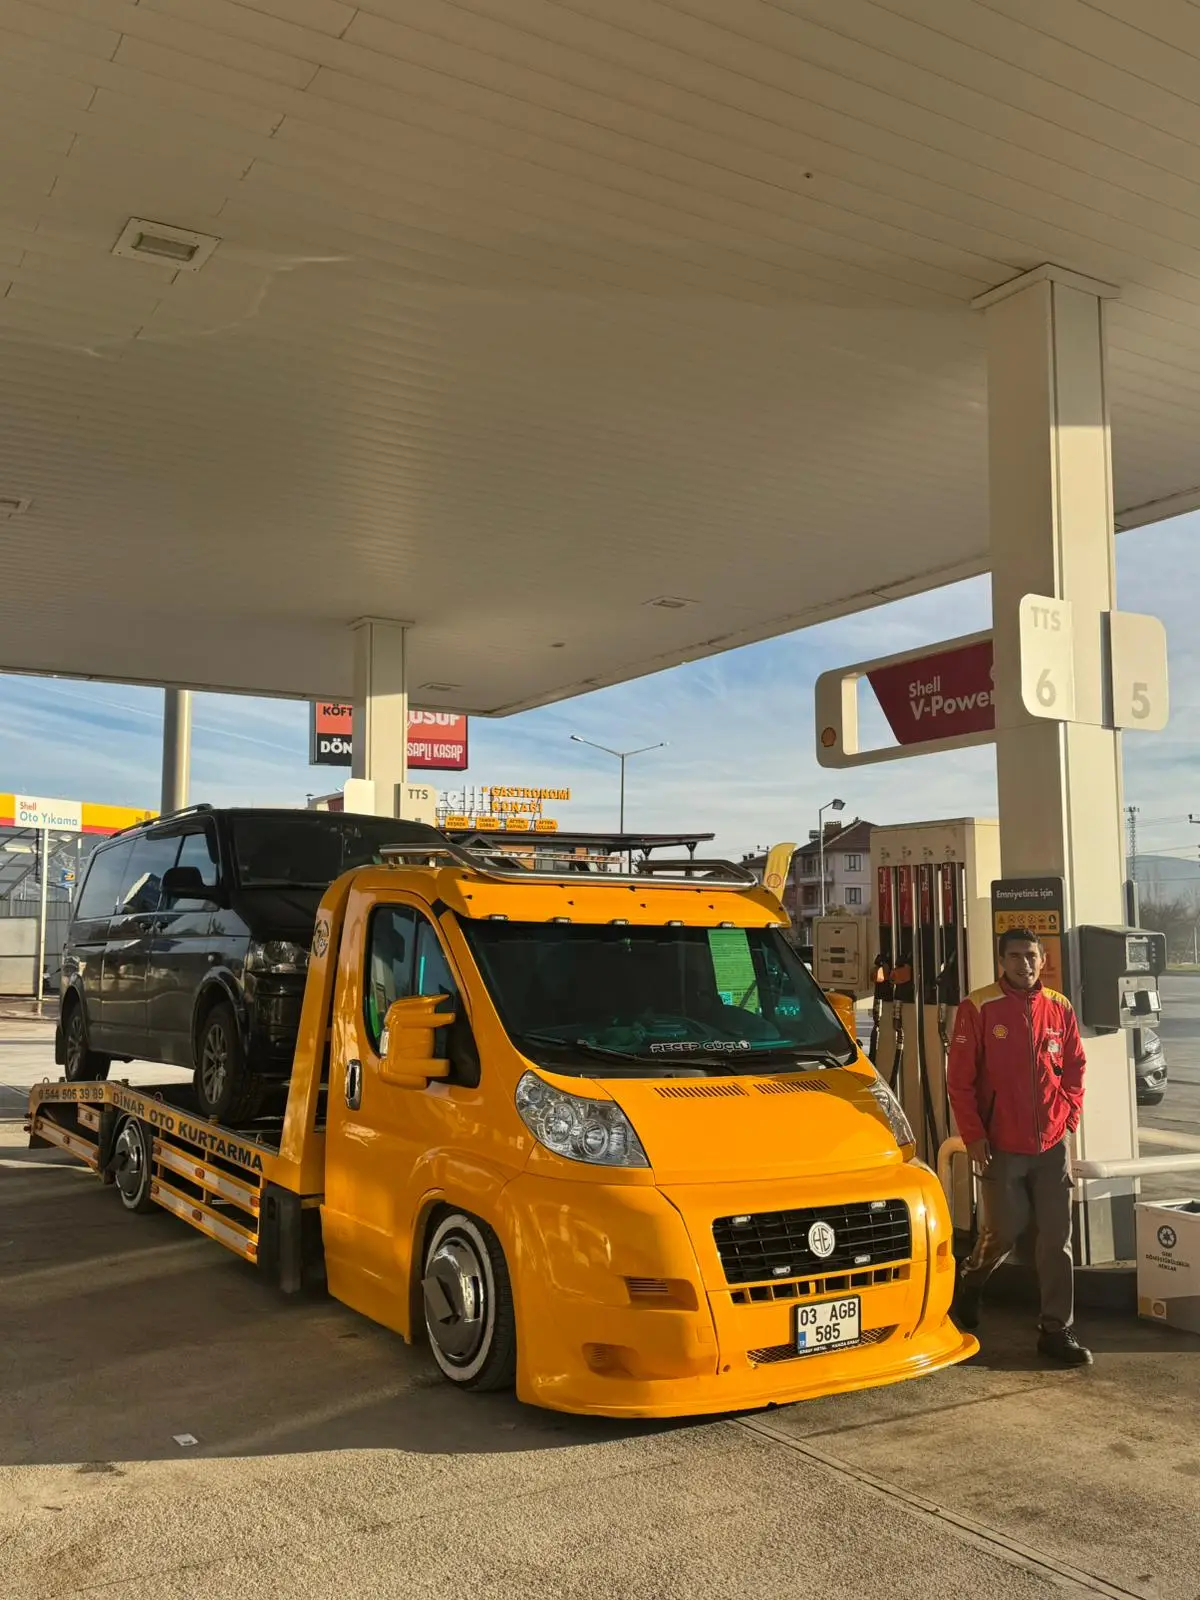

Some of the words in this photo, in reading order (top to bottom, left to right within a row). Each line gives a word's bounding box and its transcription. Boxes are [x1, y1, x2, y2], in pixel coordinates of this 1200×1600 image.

[1030, 605, 1062, 632] TTS
[908, 675, 941, 698] Shell
[1035, 668, 1057, 708] 6
[1130, 681, 1151, 720] 5
[407, 709, 461, 728] USUF
[433, 743, 463, 762] KASAP
[408, 788, 429, 800] TTS
[19, 801, 37, 811] Shell
[19, 810, 39, 823] Oto
[40, 812, 78, 826] Yıkama
[996, 889, 1039, 900] Emniyetiniz
[1040, 888, 1053, 899] için
[650, 1042, 700, 1053] RECEP
[703, 1040, 751, 1053] GÜÇLÜ
[113, 1091, 145, 1117] DİNAR
[150, 1109, 174, 1131] OTO
[178, 1122, 264, 1172] KURTARMA
[800, 1308, 817, 1326] 03
[829, 1301, 857, 1322] AGB
[815, 1322, 841, 1343] 585
